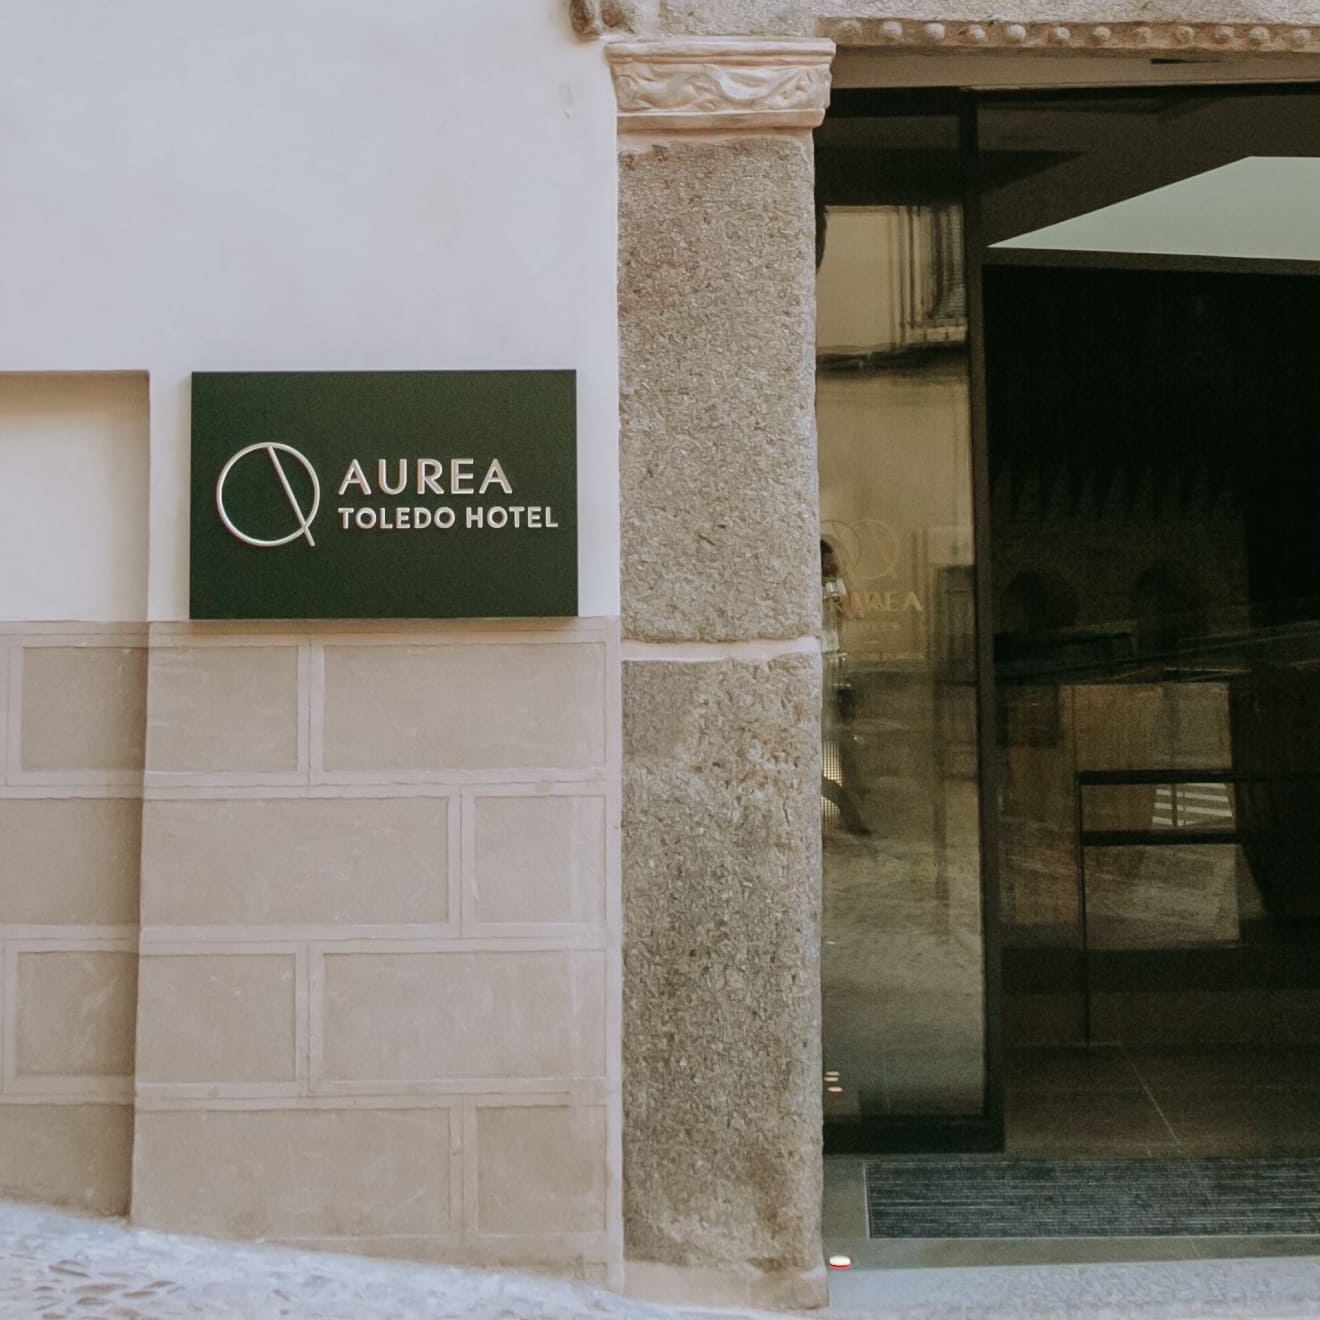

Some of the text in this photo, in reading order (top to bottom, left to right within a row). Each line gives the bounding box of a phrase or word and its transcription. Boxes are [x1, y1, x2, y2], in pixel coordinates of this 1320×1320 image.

[338, 458, 513, 496] AUREA
[338, 505, 559, 530] TOLEDO HOTEL
